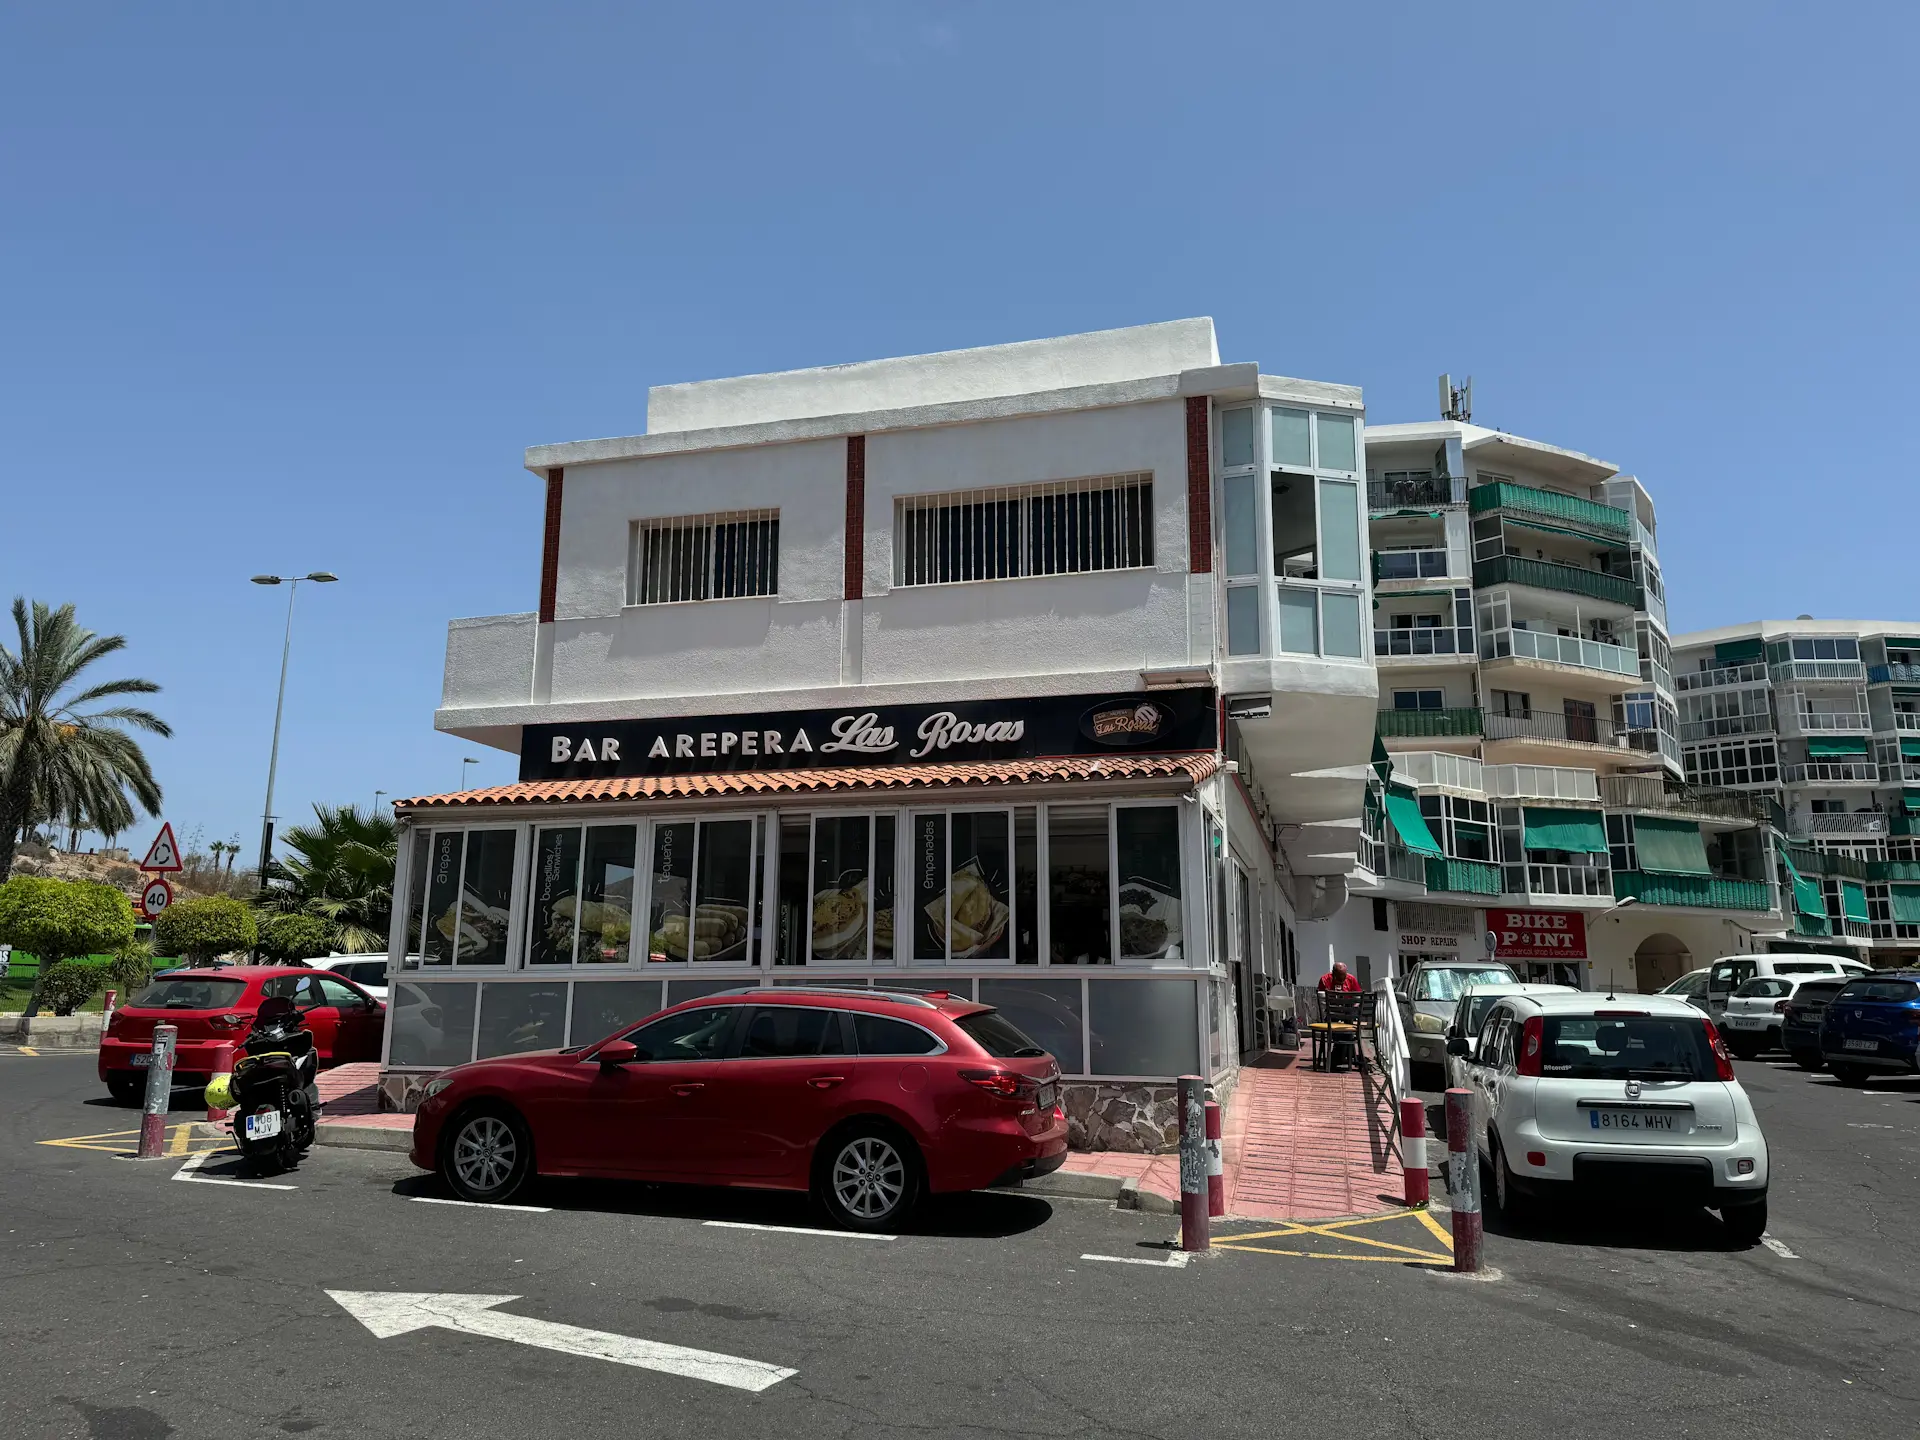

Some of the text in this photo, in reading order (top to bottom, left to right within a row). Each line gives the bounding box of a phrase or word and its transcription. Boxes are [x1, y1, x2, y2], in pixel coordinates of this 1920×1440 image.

[1096, 716, 1156, 734] Las Rosas
[551, 711, 1025, 763] BAR AREPERA Las Rosas
[436, 837, 451, 884] arepas
[552, 833, 563, 882] Sanwiches
[658, 829, 673, 883] tequeños
[923, 820, 935, 889] empanadas
[147, 893, 165, 906] 40
[1505, 913, 1568, 929] BIKE
[1401, 934, 1458, 947] SHOP REPAIRS
[254, 1123, 272, 1135] MJV
[1601, 1113, 1673, 1130] 8164 MHV
